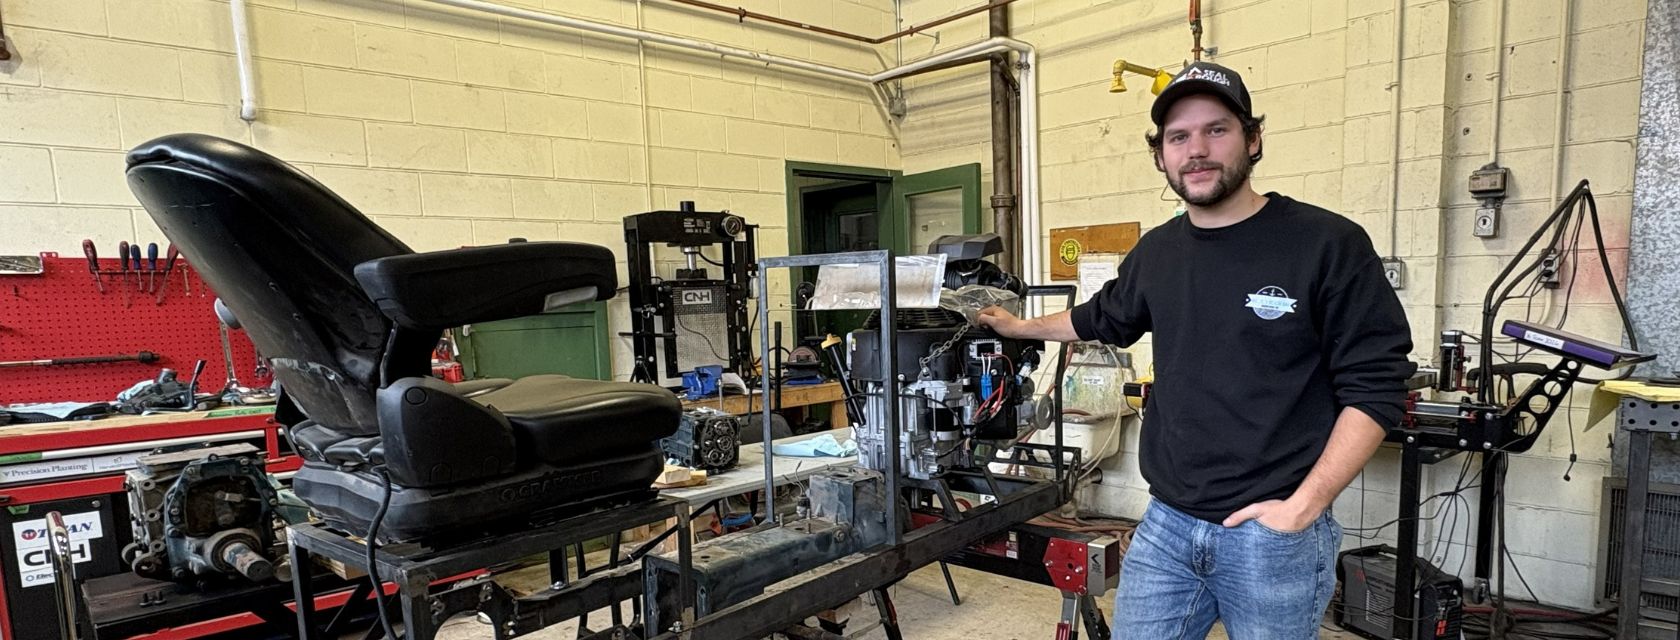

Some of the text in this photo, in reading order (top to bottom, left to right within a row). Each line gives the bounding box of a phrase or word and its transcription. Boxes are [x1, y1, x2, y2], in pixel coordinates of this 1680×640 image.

[684, 291, 710, 302] CNH
[11, 468, 49, 477] Precision
[51, 463, 88, 474] Planting
[38, 522, 92, 538] TAN
[23, 543, 86, 567] CH
